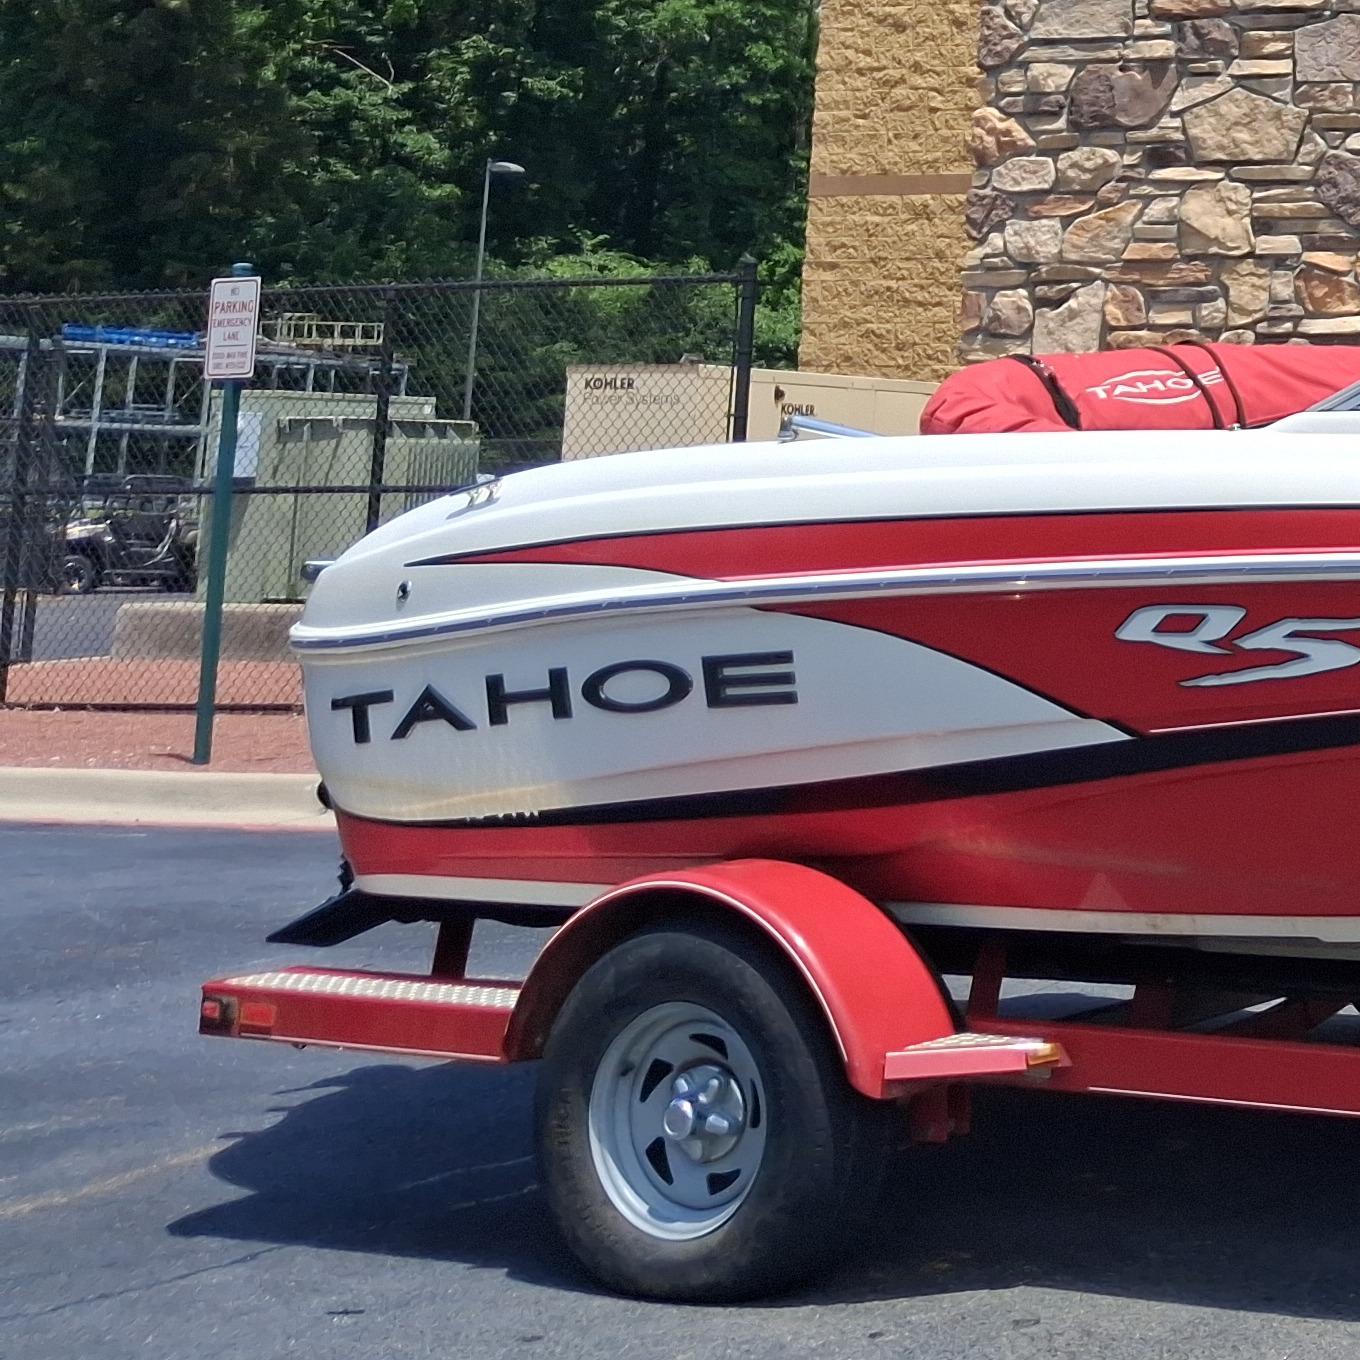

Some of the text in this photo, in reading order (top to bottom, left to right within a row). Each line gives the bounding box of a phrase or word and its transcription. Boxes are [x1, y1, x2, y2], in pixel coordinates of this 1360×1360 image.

[213, 300, 255, 314] PARKING
[212, 319, 252, 328] EMERGENCY
[223, 330, 240, 341] LANE
[584, 377, 635, 390] KOHLER
[1085, 366, 1225, 399] TAHOE
[781, 403, 815, 416] KOHLER
[330, 629, 800, 744] TAHOE
